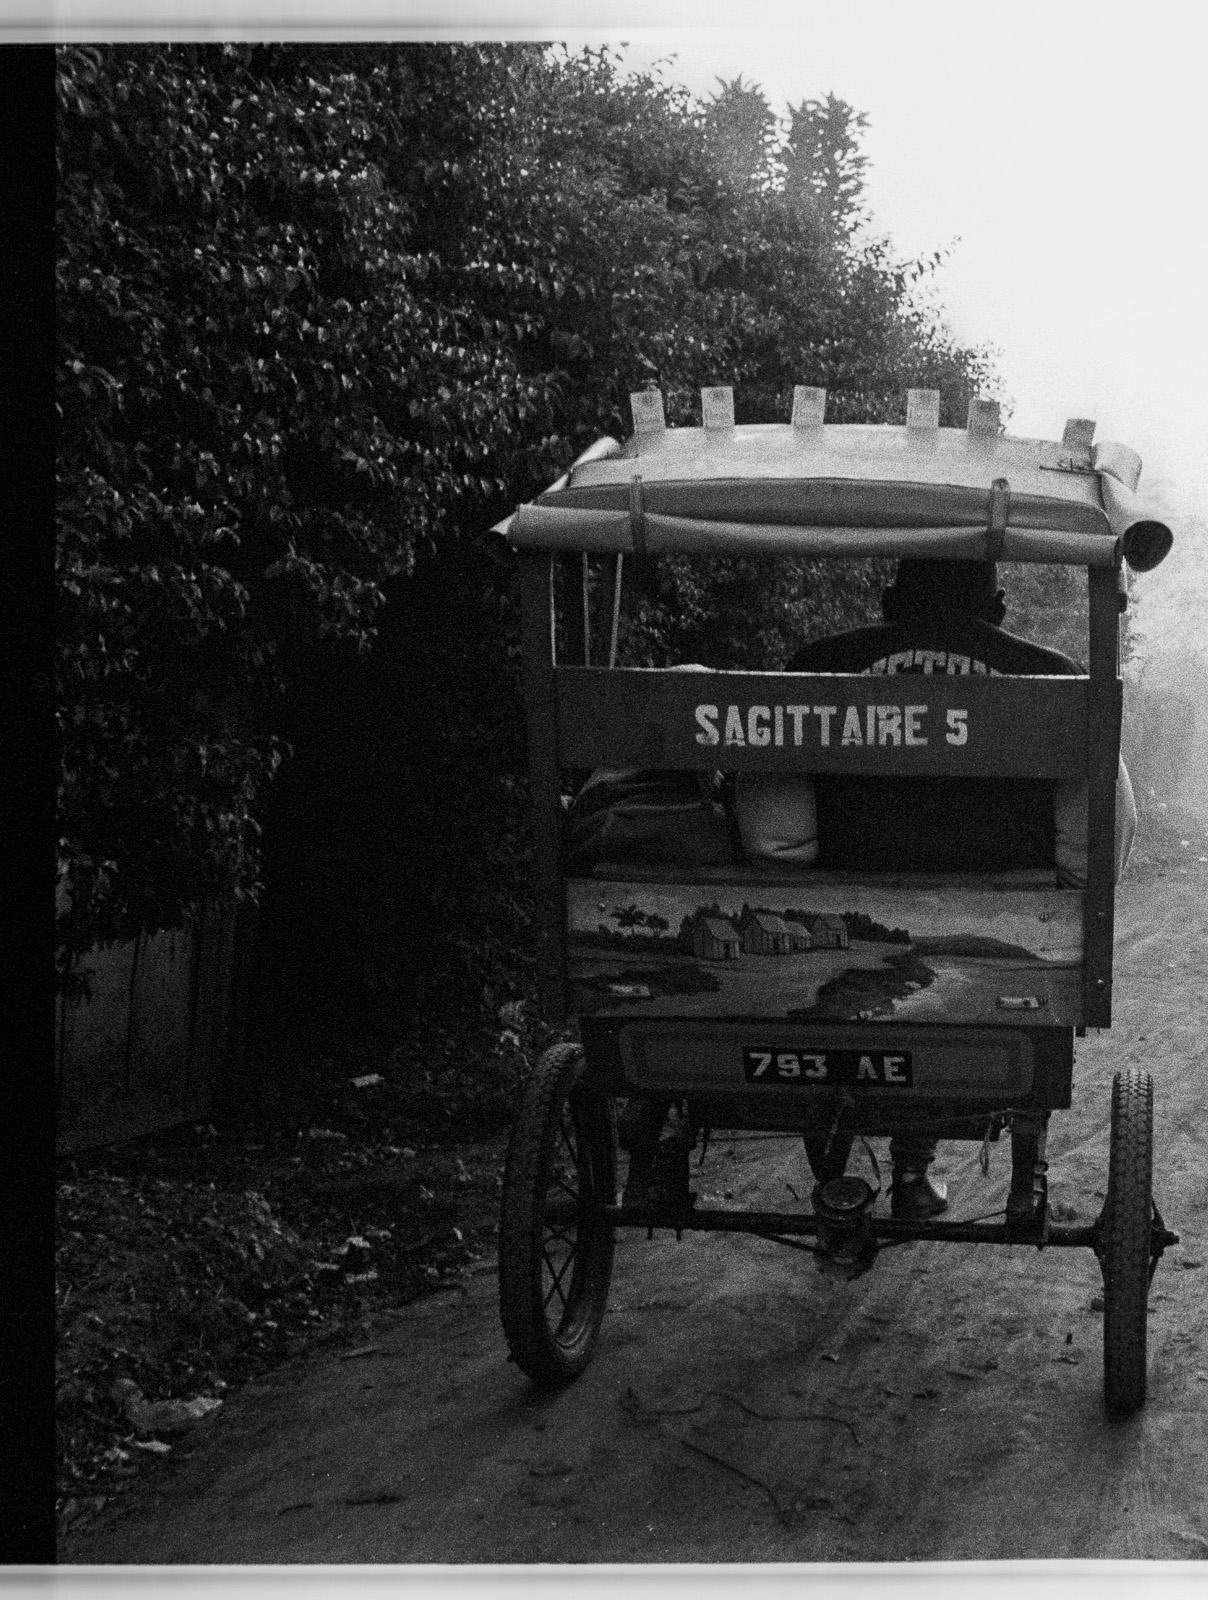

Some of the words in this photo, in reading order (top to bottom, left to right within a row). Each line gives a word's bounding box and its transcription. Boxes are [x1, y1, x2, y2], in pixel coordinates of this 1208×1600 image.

[694, 704, 928, 746] SAGITTAIRE
[945, 709, 968, 746] 5
[749, 1052, 828, 1078] 793
[856, 1055, 907, 1082] AE
